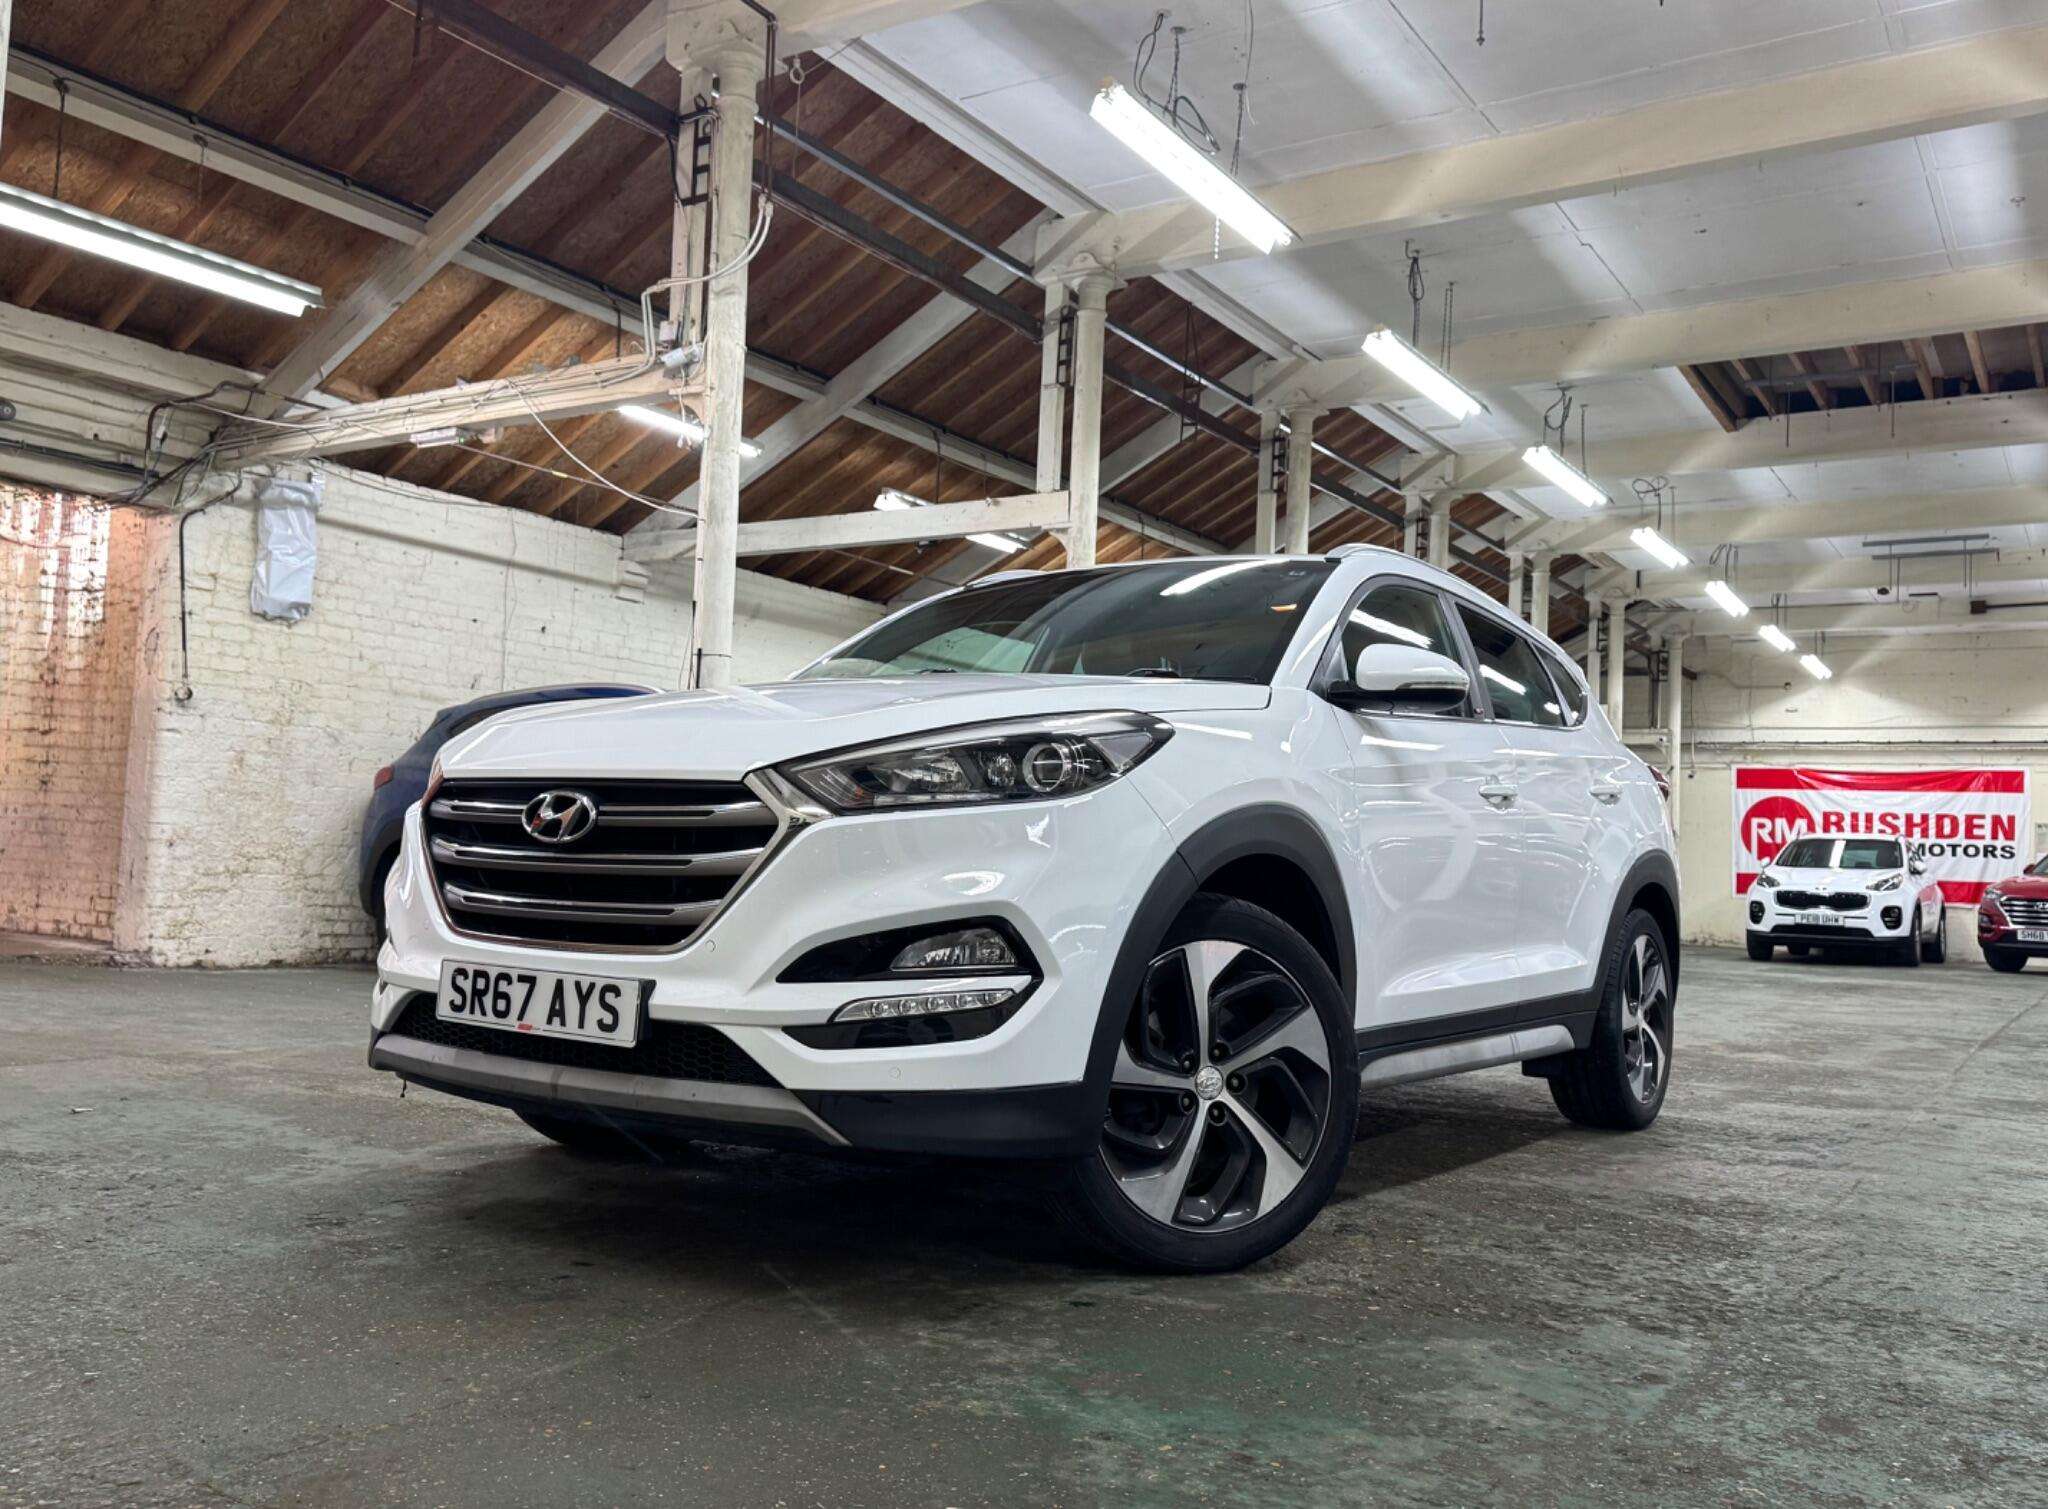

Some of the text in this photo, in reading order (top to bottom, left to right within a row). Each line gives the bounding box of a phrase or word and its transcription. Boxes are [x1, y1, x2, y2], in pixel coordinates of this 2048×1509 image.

[1751, 817, 1807, 855] RM
[1823, 811, 2015, 841] RUSHDEN
[449, 967, 621, 1033] SR67 AYS
